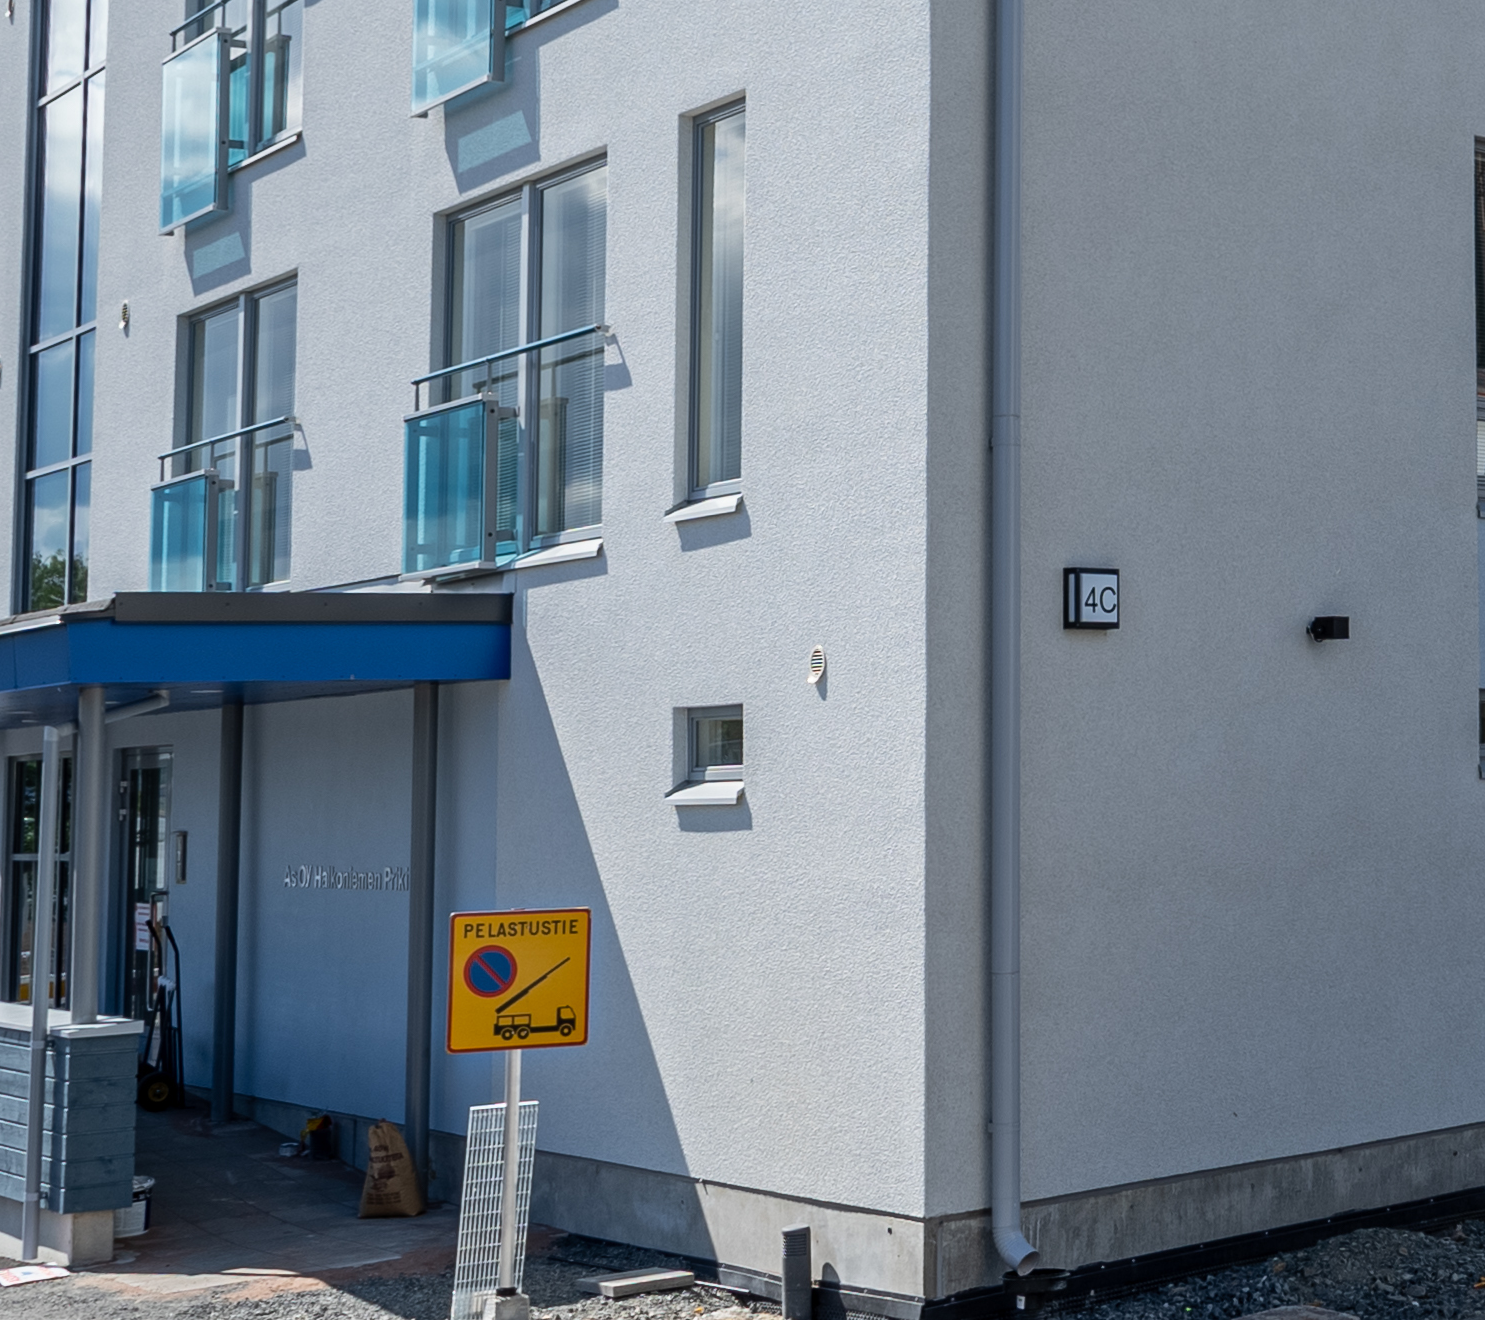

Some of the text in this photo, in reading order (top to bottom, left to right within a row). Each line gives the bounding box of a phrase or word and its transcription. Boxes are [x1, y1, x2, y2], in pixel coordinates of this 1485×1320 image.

[1084, 586, 1117, 614] 4C
[314, 865, 383, 891] Halkoniemen
[463, 919, 579, 939] PELASTUSTIE
